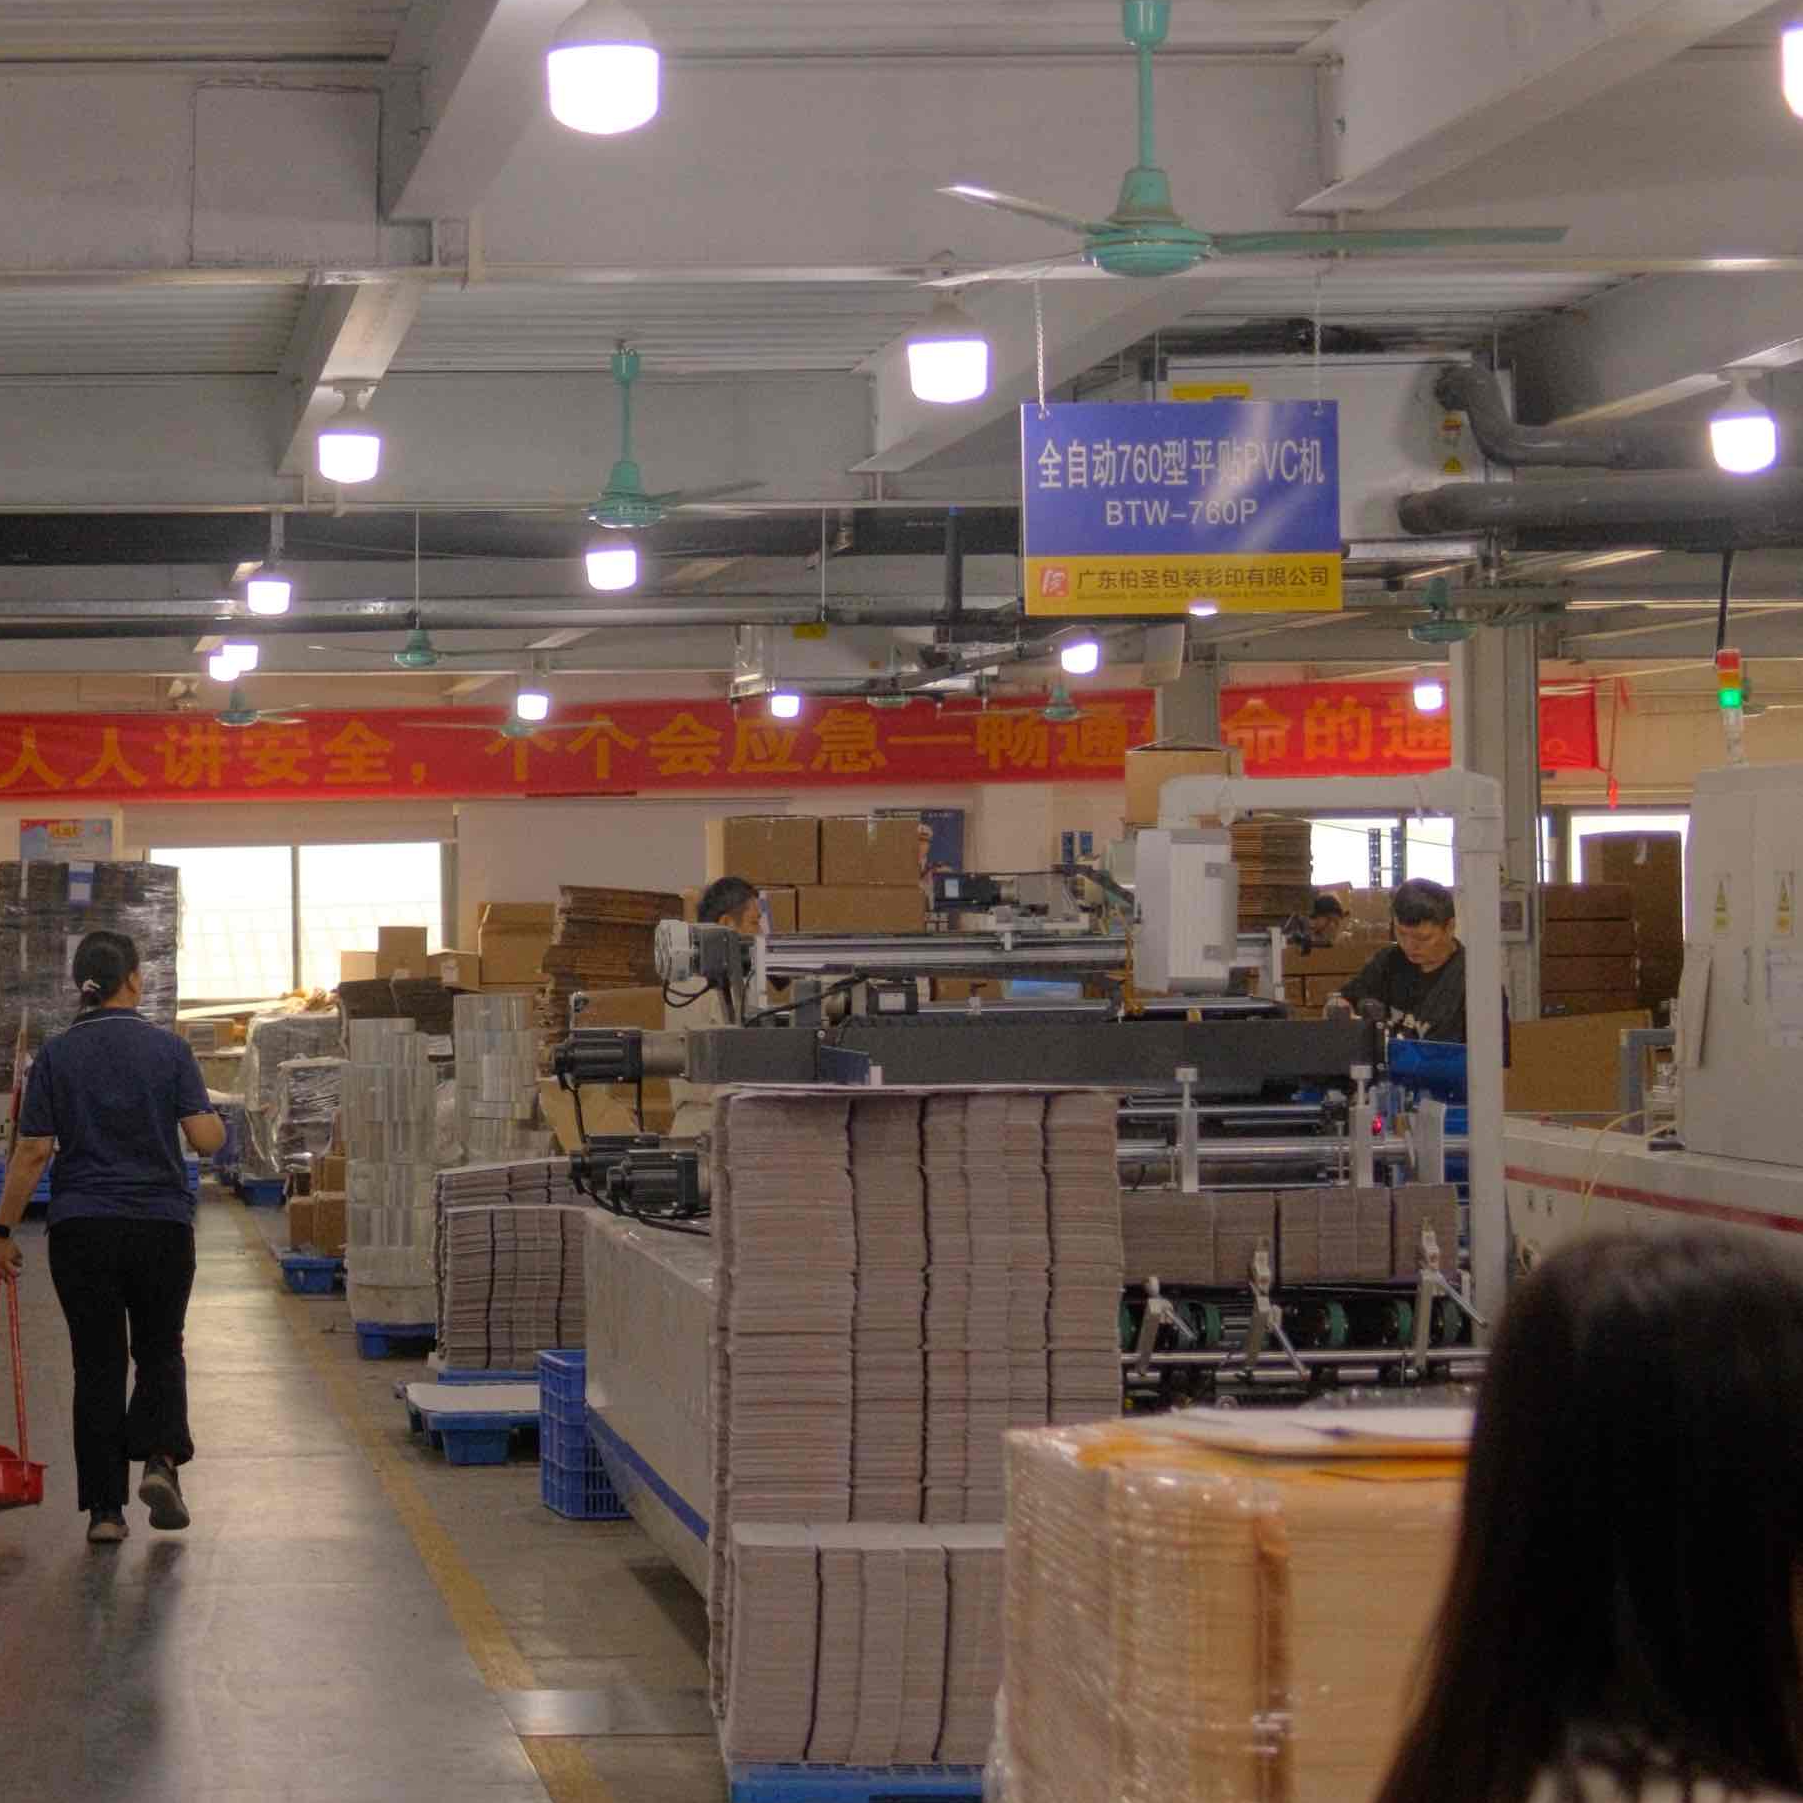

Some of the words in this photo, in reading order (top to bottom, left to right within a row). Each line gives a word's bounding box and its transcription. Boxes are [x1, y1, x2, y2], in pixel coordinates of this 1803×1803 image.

[1105, 499, 1258, 527] BTW-760P
[1077, 565, 1329, 590] 广东柏圣包装彩印有限公司
